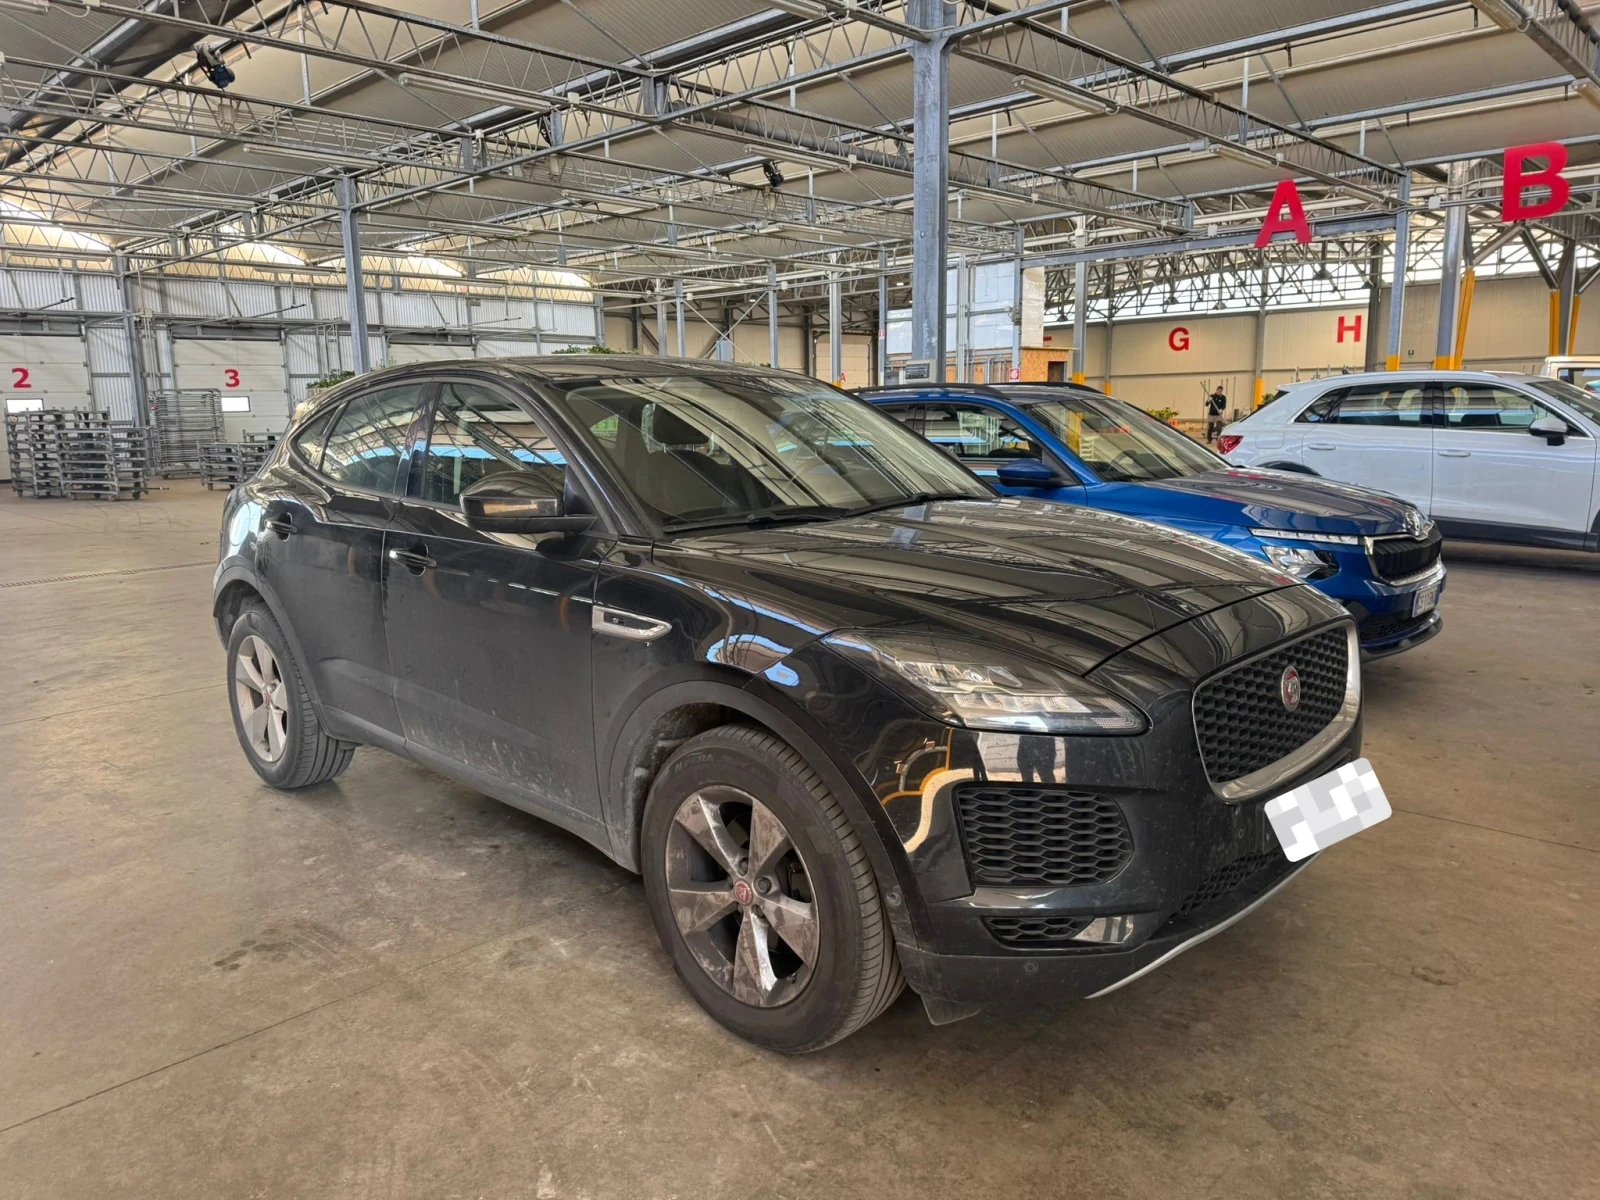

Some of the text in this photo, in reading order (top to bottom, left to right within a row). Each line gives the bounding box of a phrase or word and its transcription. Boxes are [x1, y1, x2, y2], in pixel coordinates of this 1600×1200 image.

[1502, 141, 1571, 223] B
[1254, 179, 1312, 248] A
[1168, 327, 1191, 353] G
[1336, 314, 1363, 344] H
[11, 367, 32, 389] 2
[224, 369, 241, 388] 3
